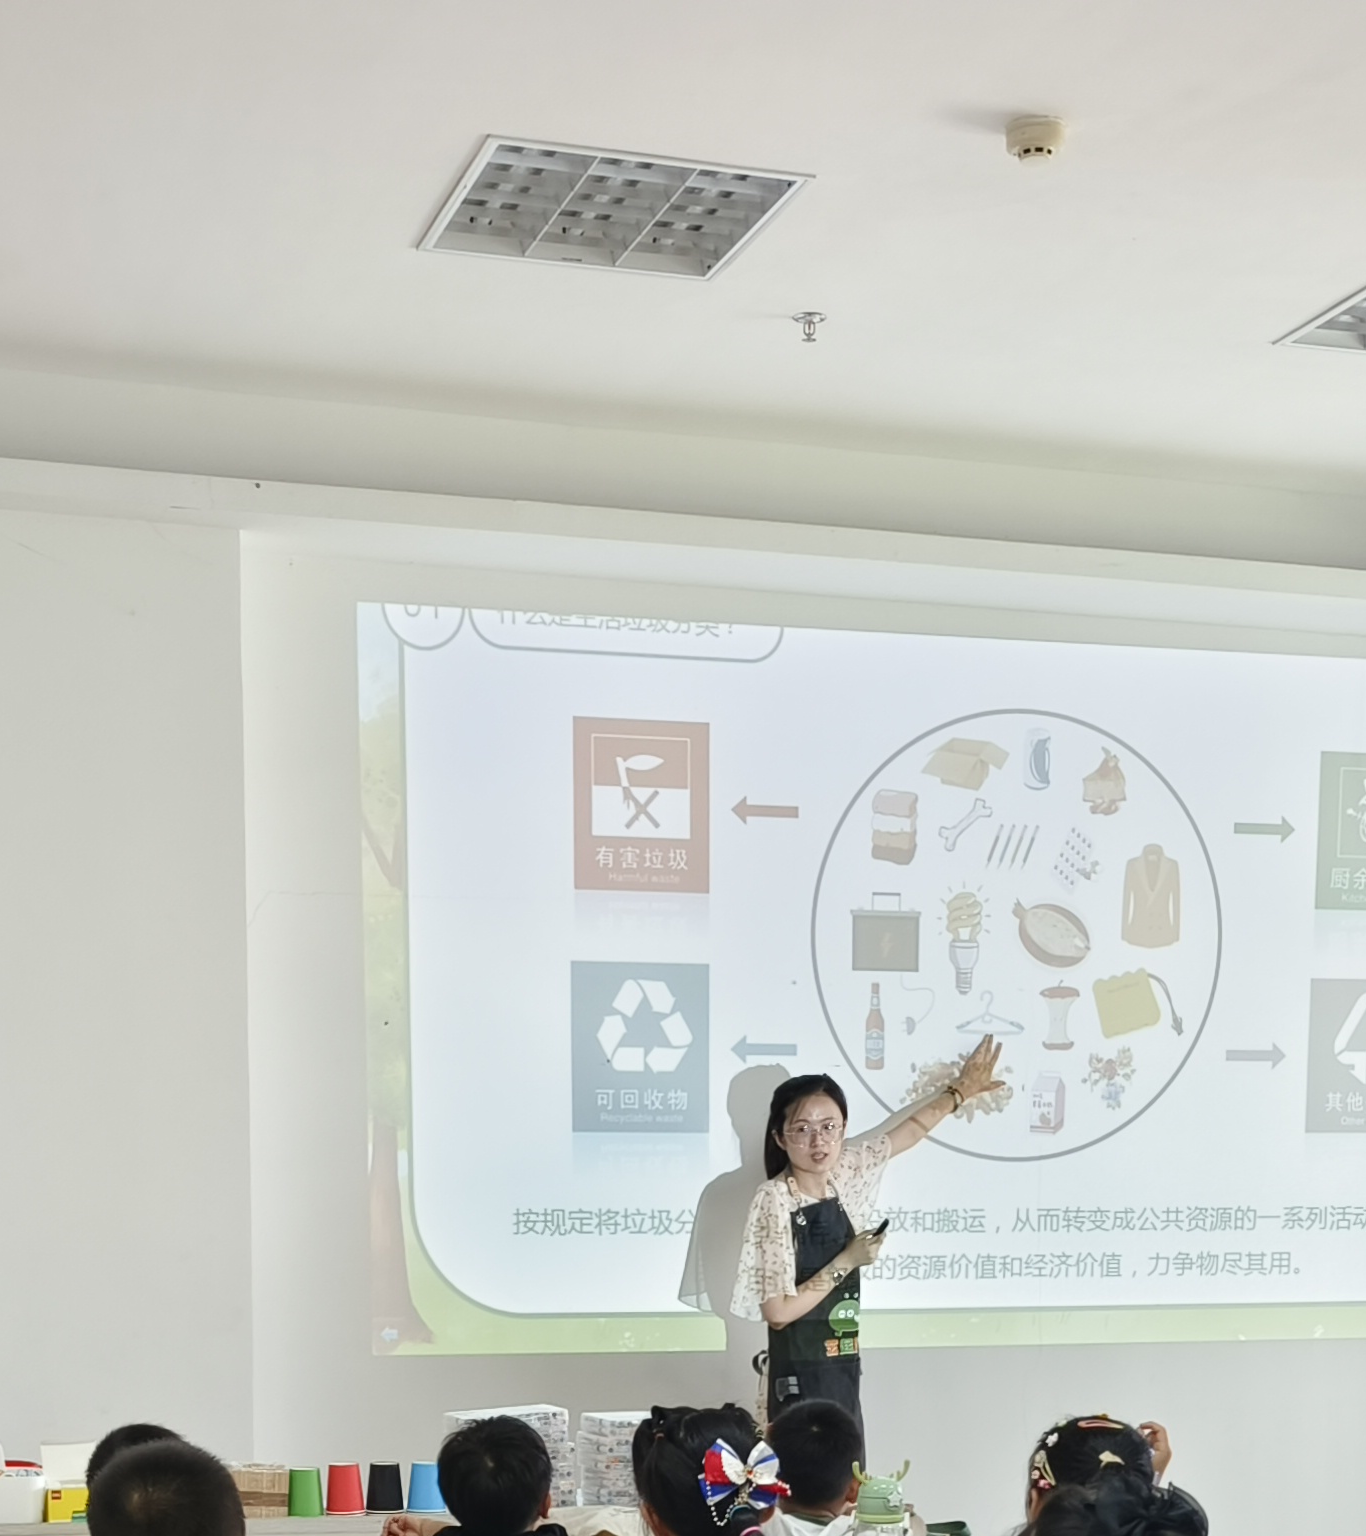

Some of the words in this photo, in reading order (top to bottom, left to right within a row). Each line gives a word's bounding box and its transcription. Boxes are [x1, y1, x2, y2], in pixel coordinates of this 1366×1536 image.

[595, 846, 688, 870] 有害垃圾
[595, 1088, 688, 1111] 可回收物
